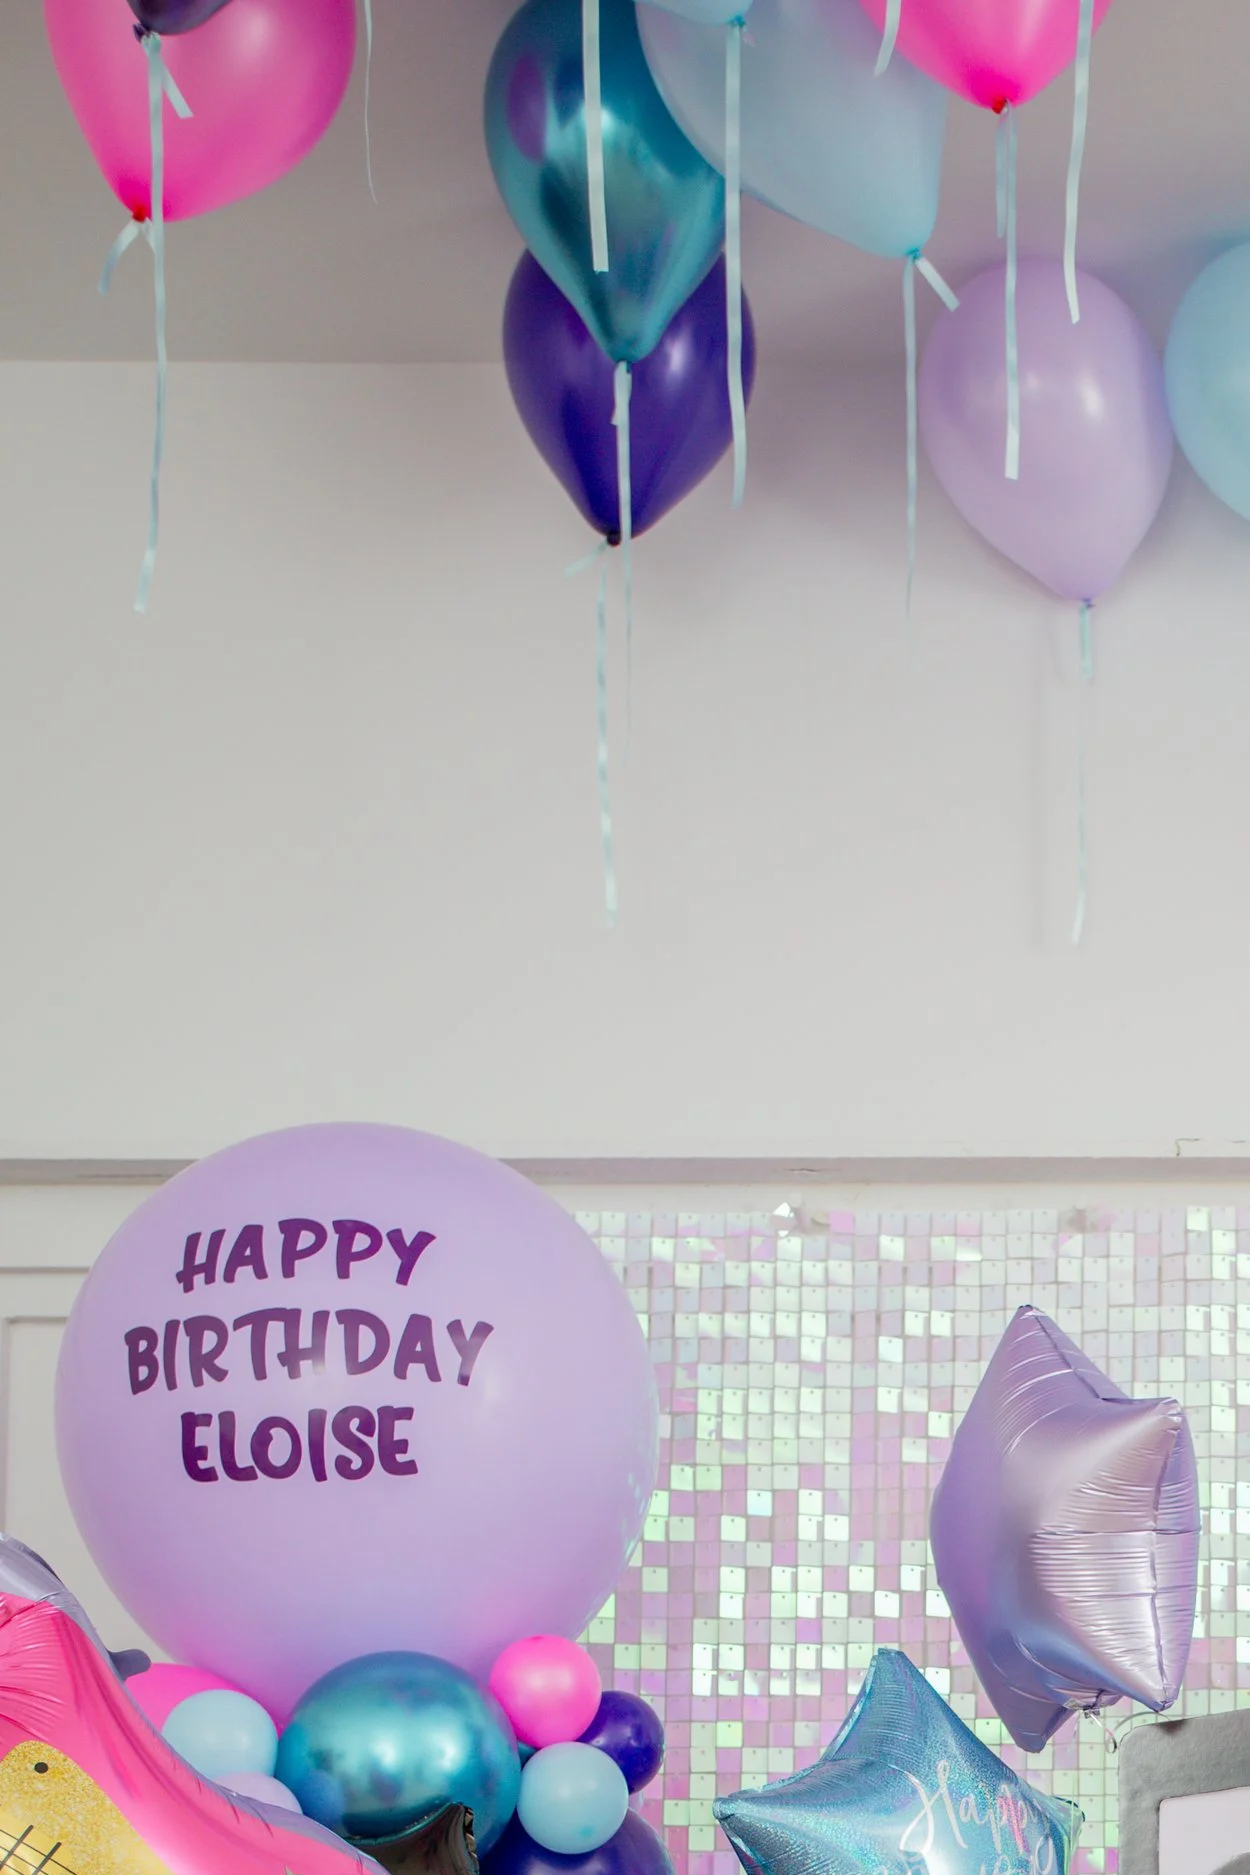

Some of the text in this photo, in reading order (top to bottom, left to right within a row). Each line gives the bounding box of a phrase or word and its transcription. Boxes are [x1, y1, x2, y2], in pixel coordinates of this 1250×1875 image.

[176, 1218, 436, 1293] HAPPY
[124, 1307, 494, 1395] BIRTHDAY
[181, 1405, 418, 1482] ELOISE
